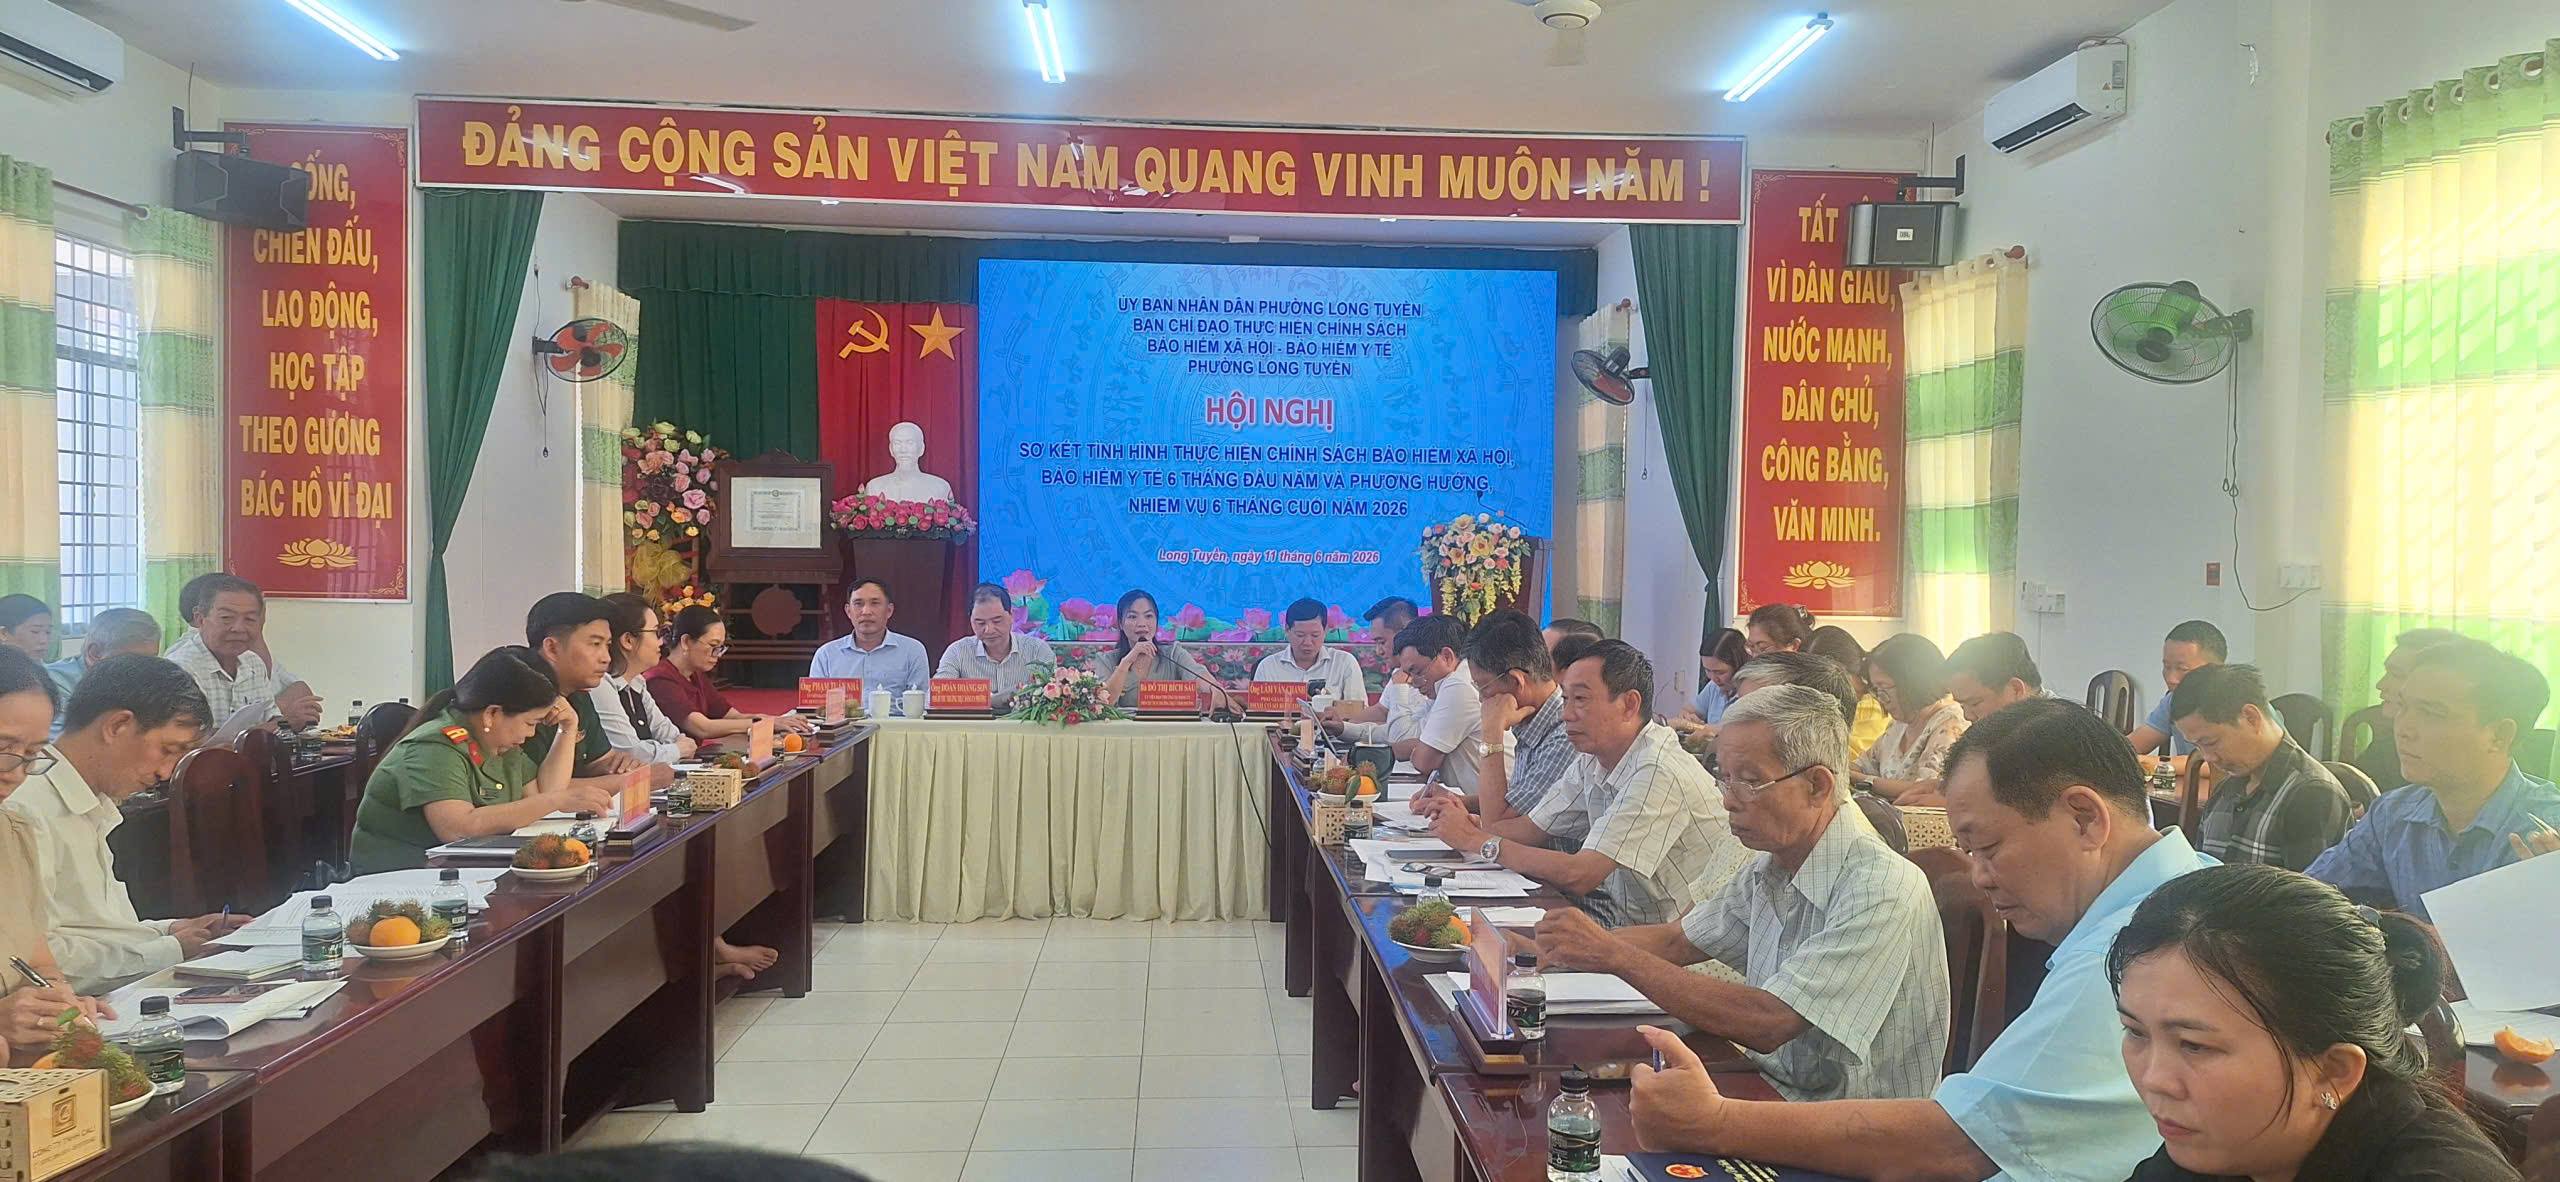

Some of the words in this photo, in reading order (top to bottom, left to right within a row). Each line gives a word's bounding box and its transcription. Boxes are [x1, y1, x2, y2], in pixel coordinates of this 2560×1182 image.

[463, 106, 600, 169] ĐẢNG
[619, 117, 755, 187] CỘNG
[773, 116, 868, 181] SẢN
[888, 130, 998, 197] VIỆT
[1017, 140, 1117, 190] NAM
[1134, 147, 1296, 197] QUANG
[1312, 152, 1421, 199] VINH
[1439, 146, 1571, 201] MUÔN
[1585, 146, 1683, 202] NĂM
[291, 150, 356, 210] ỐNG,
[1799, 193, 1839, 243] TẤT
[327, 215, 378, 275] ĐẤU,
[1767, 259, 1787, 303] VÌ
[1792, 260, 1834, 303] DÂN
[262, 289, 302, 328] LAO
[310, 281, 378, 338] ĐỘNG,
[1133, 318, 1164, 332] BAN
[1197, 319, 1229, 337] ĐẠO
[1234, 320, 1275, 337] THỰC
[1317, 318, 1362, 336] CHÍNH
[1366, 319, 1407, 336] SÁCH
[1142, 298, 1173, 312] BAN
[1178, 296, 1219, 313] NHÂN
[1223, 297, 1254, 313] DÂN
[1259, 298, 1324, 315] PHƯỜNG
[1328, 302, 1369, 316] LONG
[1188, 356, 1254, 374] PHƯỜNG
[1258, 361, 1299, 375] LONG
[1224, 337, 1243, 354] XÃ
[1361, 342, 1372, 357] Y
[1763, 319, 1820, 363] NƯỚC
[1826, 326, 1893, 371] MẠNH,
[270, 352, 314, 400] HỌC
[322, 346, 365, 400] TẬP
[1206, 391, 1255, 430] HỘI
[1264, 398, 1333, 431] NGHỊ
[1781, 379, 1824, 423] DÂN
[1831, 374, 1880, 430] CHỦ,
[239, 415, 298, 455] THEO
[304, 408, 381, 456] GƯƠNG
[1019, 442, 1044, 458] SƠ
[1086, 440, 1124, 460] TÌNH
[1129, 441, 1168, 460] HÌNH
[1173, 444, 1219, 463] THỰC
[1267, 443, 1317, 462] CHÍNH
[1322, 443, 1367, 463] SÁCH
[1372, 444, 1407, 463] BẢO
[1456, 446, 1478, 464] XÃ
[1042, 466, 1077, 485] BẢO
[1127, 471, 1139, 486] Y
[1167, 472, 1176, 486] 6
[1182, 469, 1238, 487] THÁNG
[1282, 470, 1318, 488] NĂM
[1323, 470, 1345, 489] VÀ
[1350, 474, 1422, 490] PHƯƠNG
[1761, 438, 1820, 483] CÔNG
[1825, 432, 1890, 489] BẰNG,
[240, 470, 284, 518] BÁC
[291, 465, 322, 518] HỒ
[328, 473, 350, 518] VĨ
[356, 481, 392, 529] ĐẠI
[1186, 499, 1207, 516] VỤ
[1212, 500, 1221, 514] 6
[1227, 497, 1282, 515] THÁNG
[1332, 497, 1368, 515] NĂM
[1372, 501, 1408, 516] 2026
[1773, 498, 1815, 543] VĂN
[1821, 506, 1881, 543] MINH.
[1159, 550, 1189, 564] Long
[1233, 553, 1261, 565] ngày
[1265, 551, 1276, 562] 11
[1280, 551, 1312, 564] tháng
[1316, 552, 1322, 563] 6
[1325, 552, 1349, 563] năm
[1353, 552, 1380, 563] 2026
